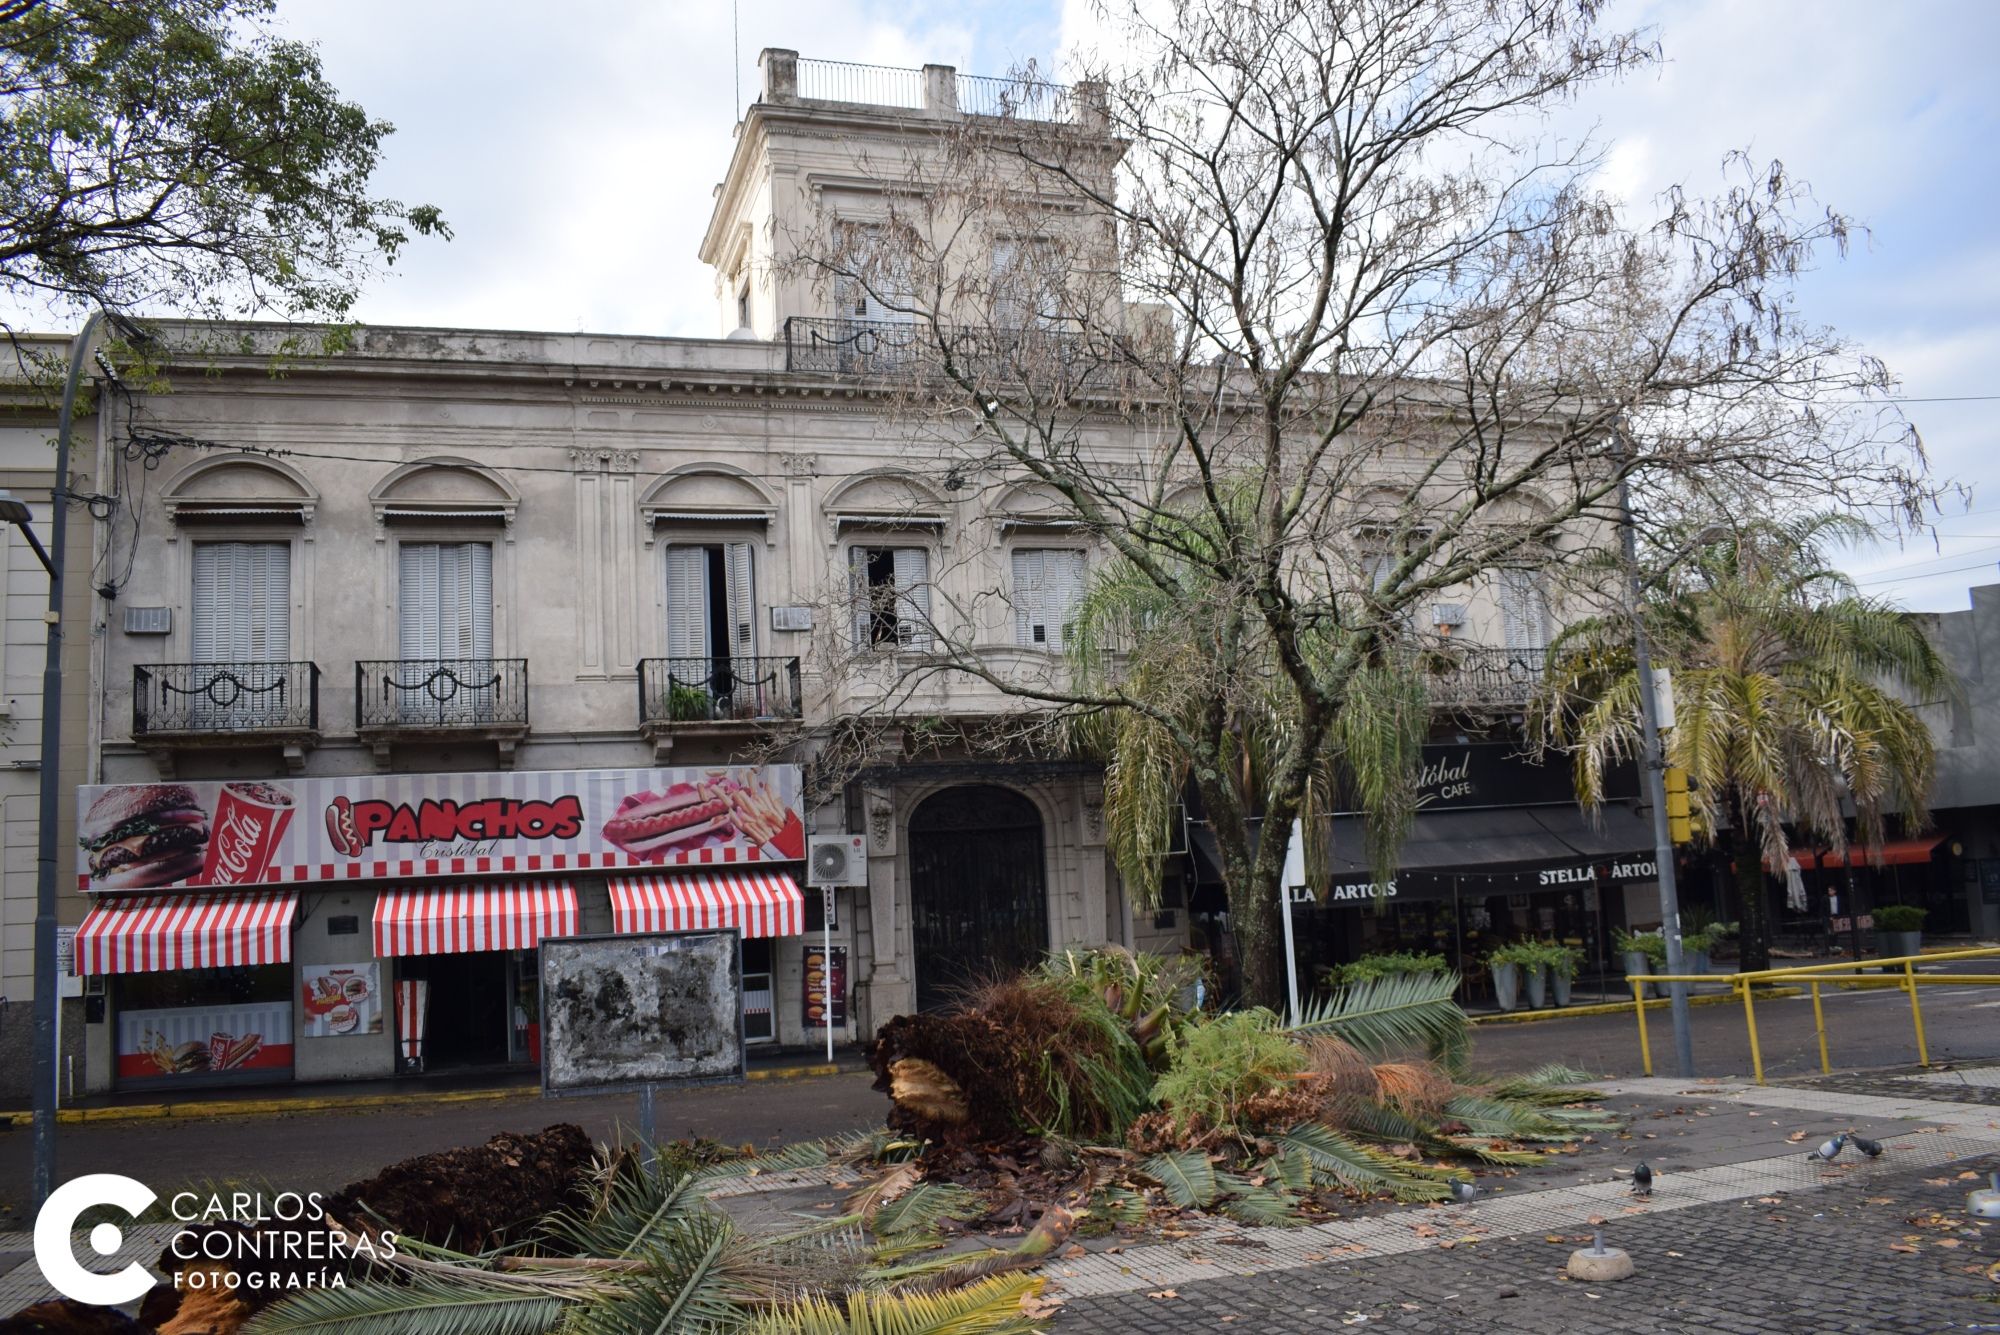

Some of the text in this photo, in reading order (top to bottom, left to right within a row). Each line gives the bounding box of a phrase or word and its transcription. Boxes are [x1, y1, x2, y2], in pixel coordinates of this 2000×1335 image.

[1441, 782, 1471, 799] CAFE
[350, 795, 585, 846] PANCHOS
[415, 836, 499, 859] Cristóbal
[1540, 862, 1658, 885] STELLA ARTOI
[1333, 881, 1398, 900] ARTOIS
